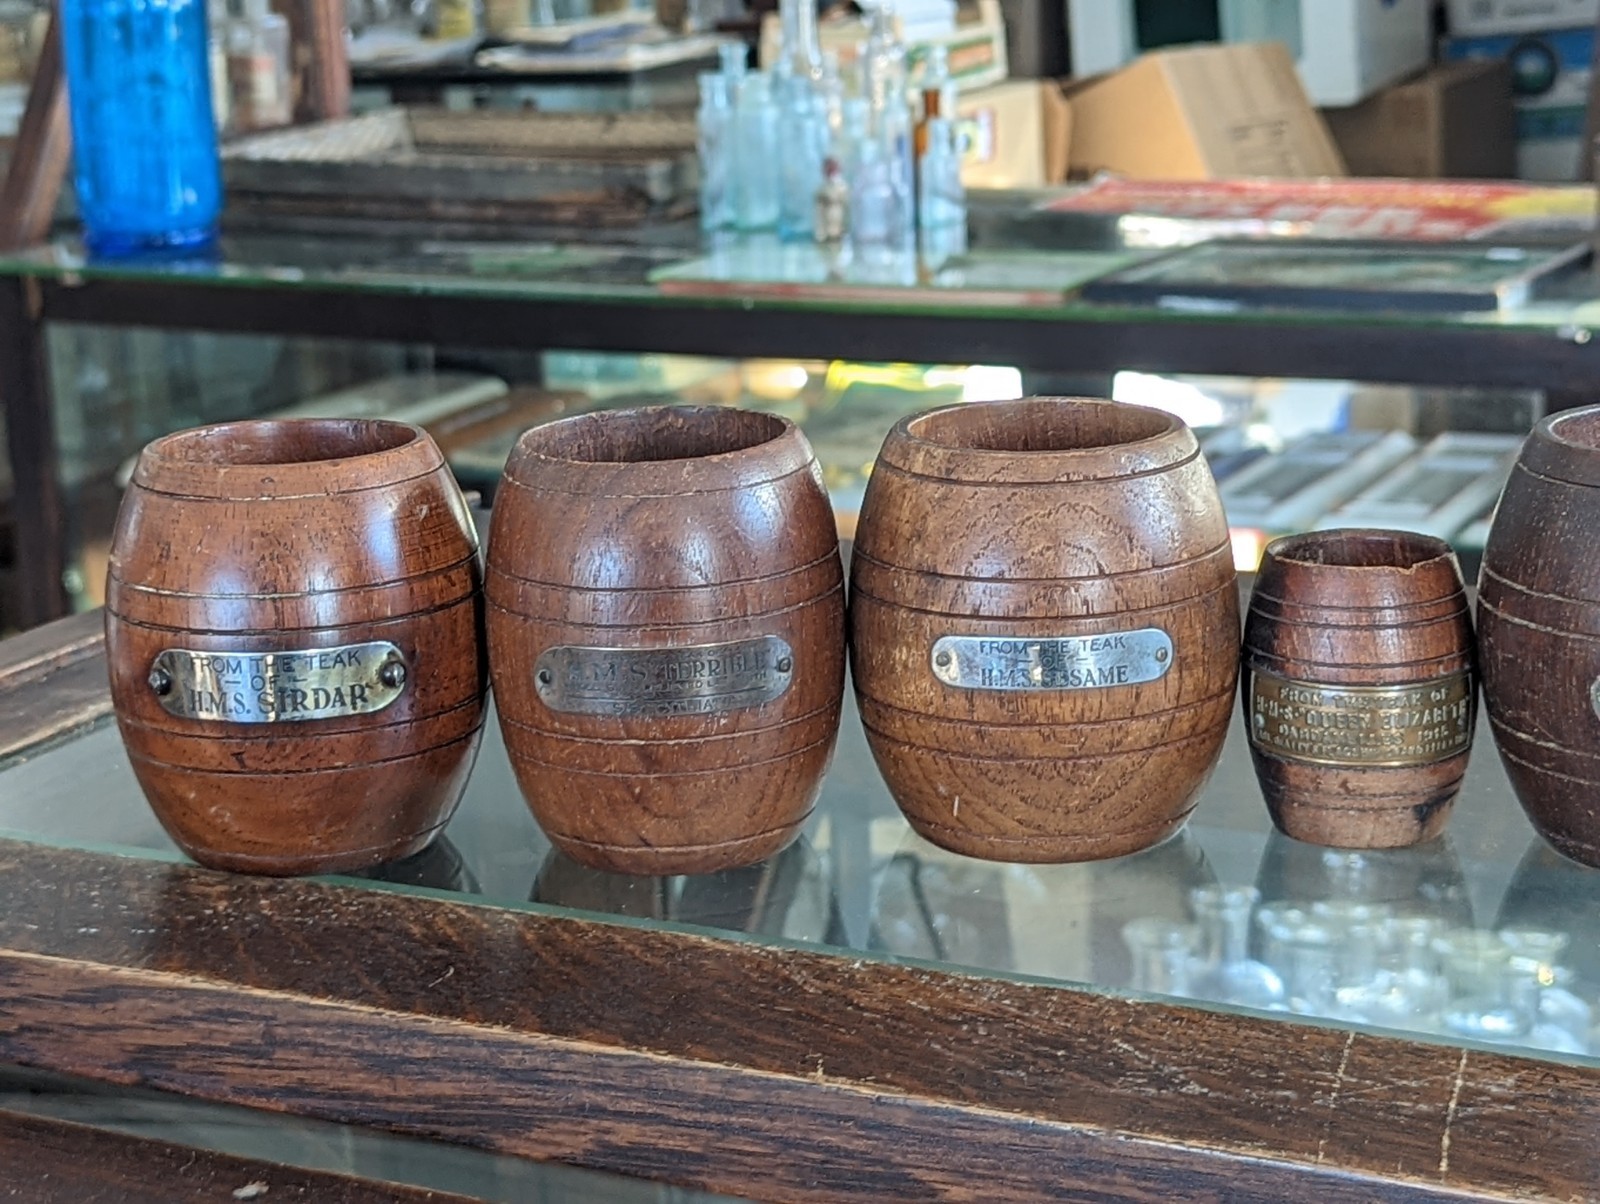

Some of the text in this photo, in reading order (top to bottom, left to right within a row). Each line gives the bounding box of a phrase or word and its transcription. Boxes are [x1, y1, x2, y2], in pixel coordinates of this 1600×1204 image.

[980, 635, 1126, 655] FROM THE TEAK
[191, 649, 362, 675] FROM THE TEAK
[1041, 655, 1066, 669] OF
[250, 675, 281, 692] OF
[980, 665, 1129, 688] H.M.S. SESAME
[190, 682, 369, 714] H.M.S. SIRDAR
[1279, 687, 1324, 706] FROM
[1431, 687, 1449, 701] OF
